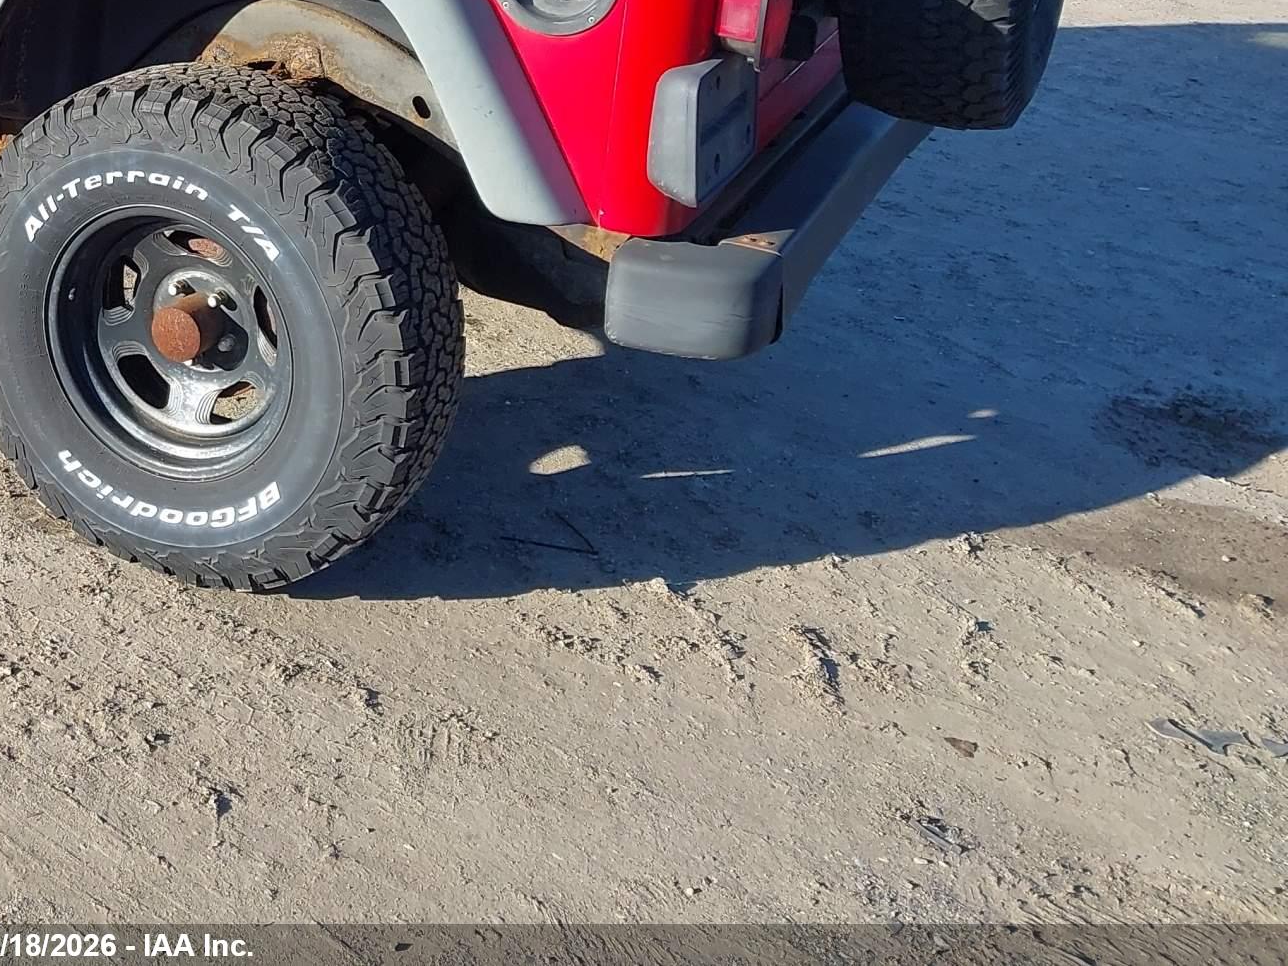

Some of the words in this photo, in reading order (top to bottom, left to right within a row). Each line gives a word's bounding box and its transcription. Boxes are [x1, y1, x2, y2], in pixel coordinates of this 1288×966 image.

[24, 169, 210, 244] All-Terrain
[226, 204, 281, 263] T/A
[57, 449, 282, 529] BFGoodrich
